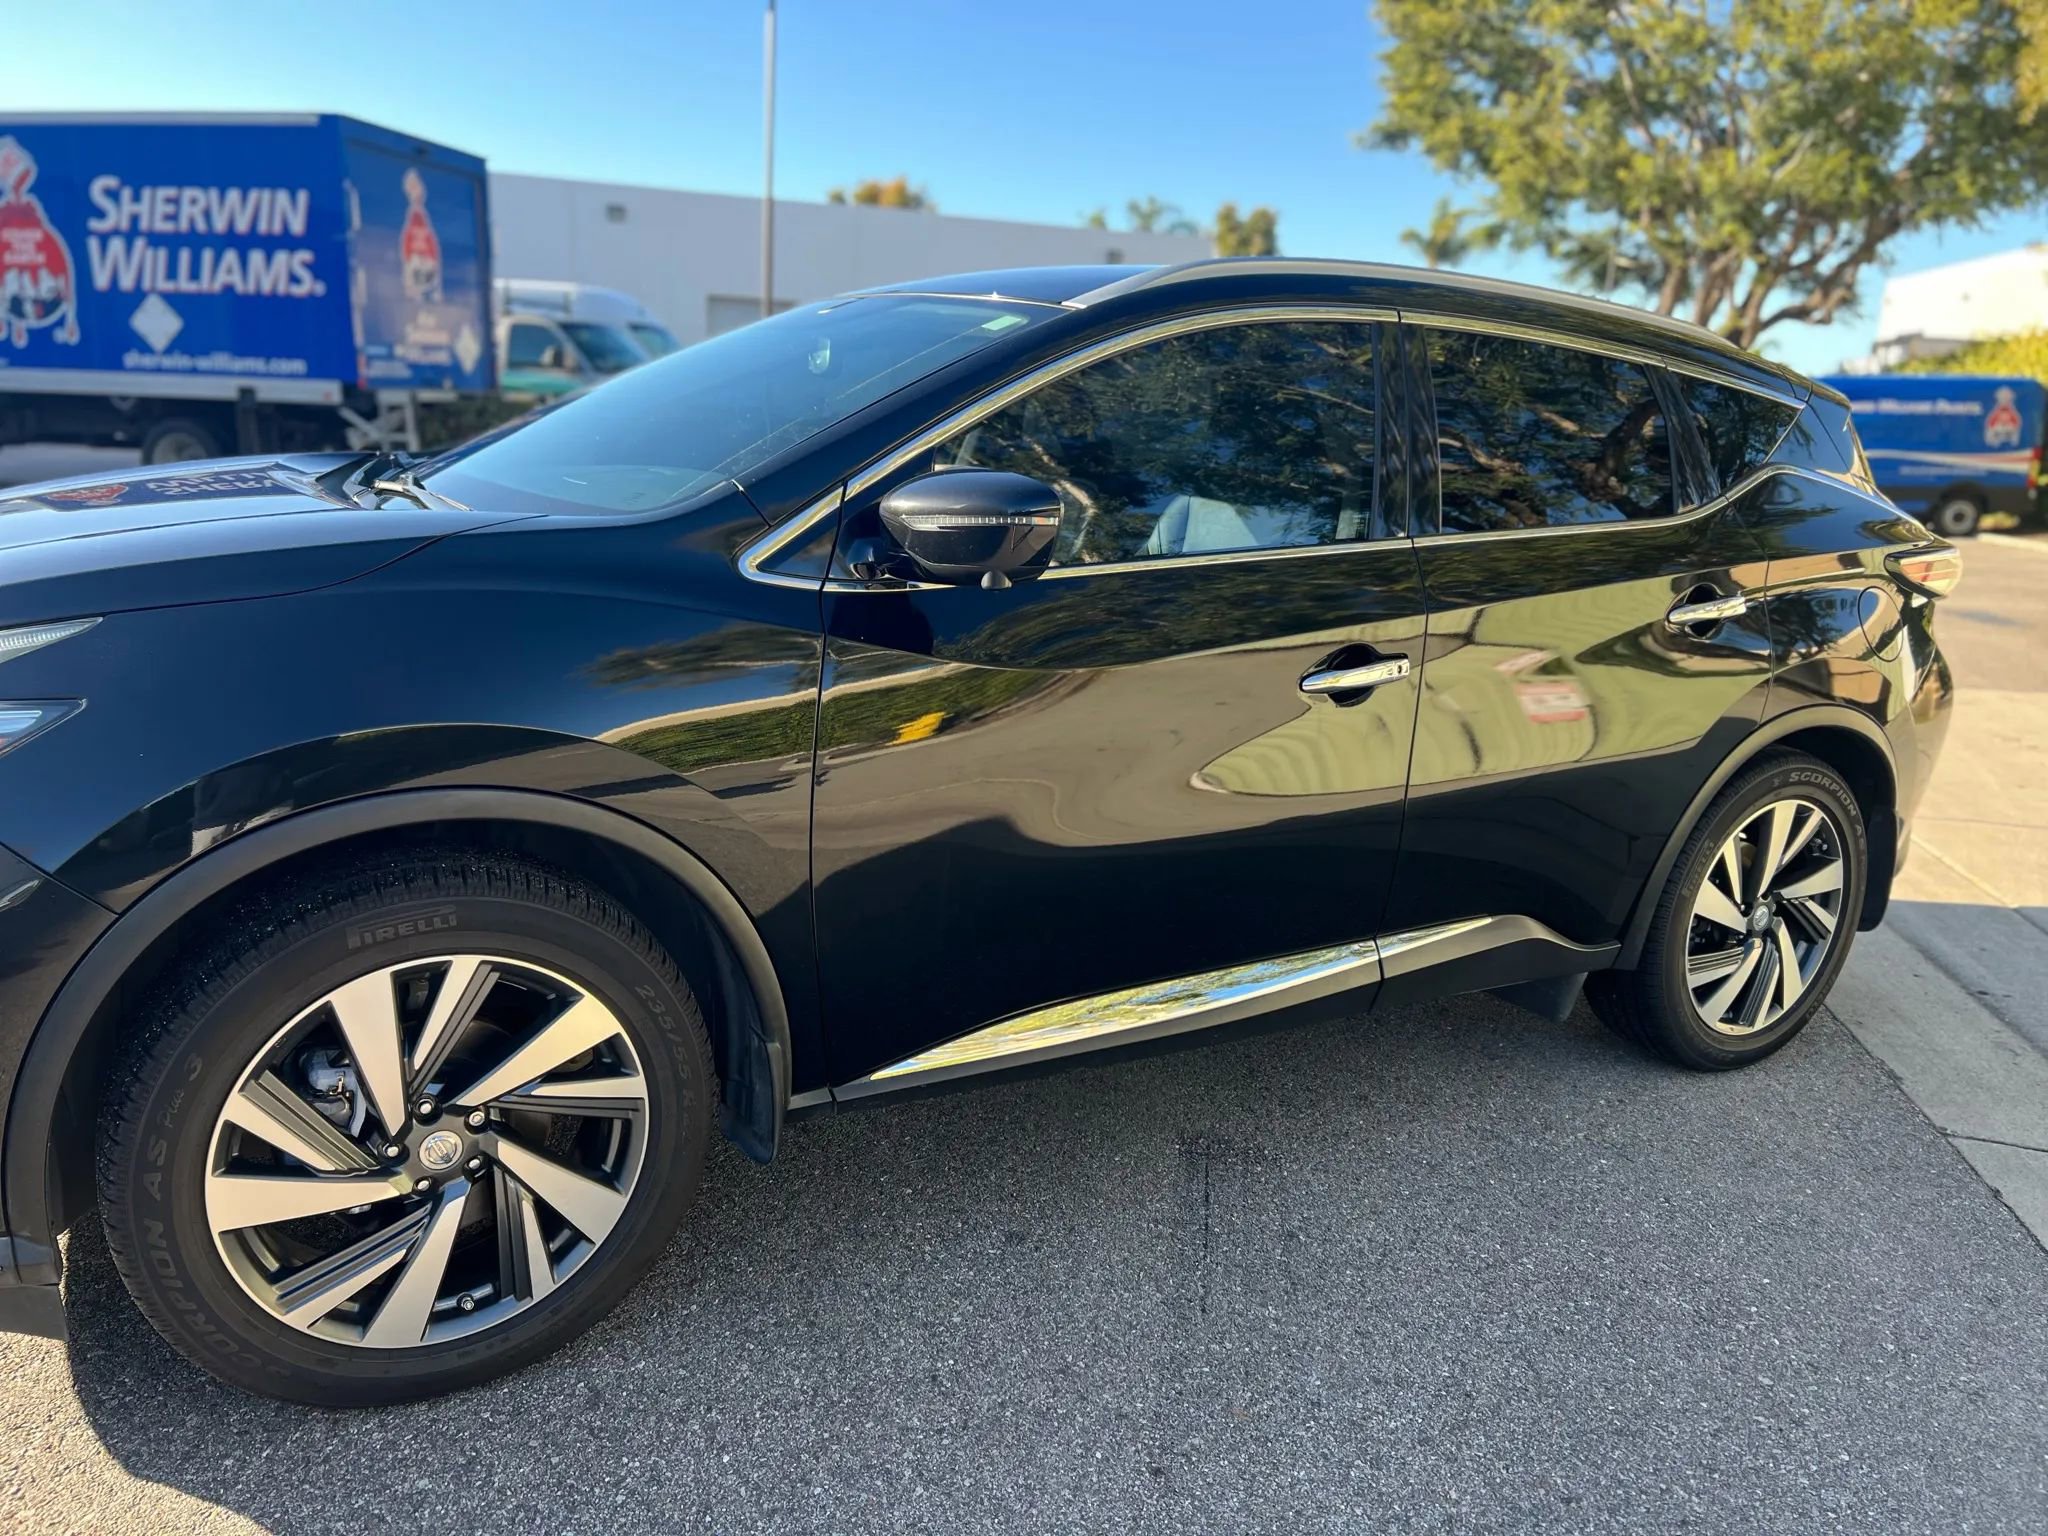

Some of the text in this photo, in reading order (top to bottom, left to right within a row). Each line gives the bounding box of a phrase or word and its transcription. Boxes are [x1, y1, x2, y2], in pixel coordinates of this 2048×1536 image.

[87, 174, 311, 236] SHERWIN
[1788, 771, 1857, 817] SCORPION
[345, 904, 458, 950] PIRELLI
[634, 984, 692, 1081] 235/55
[143, 1135, 168, 1201] AS
[183, 1052, 204, 1083] 3
